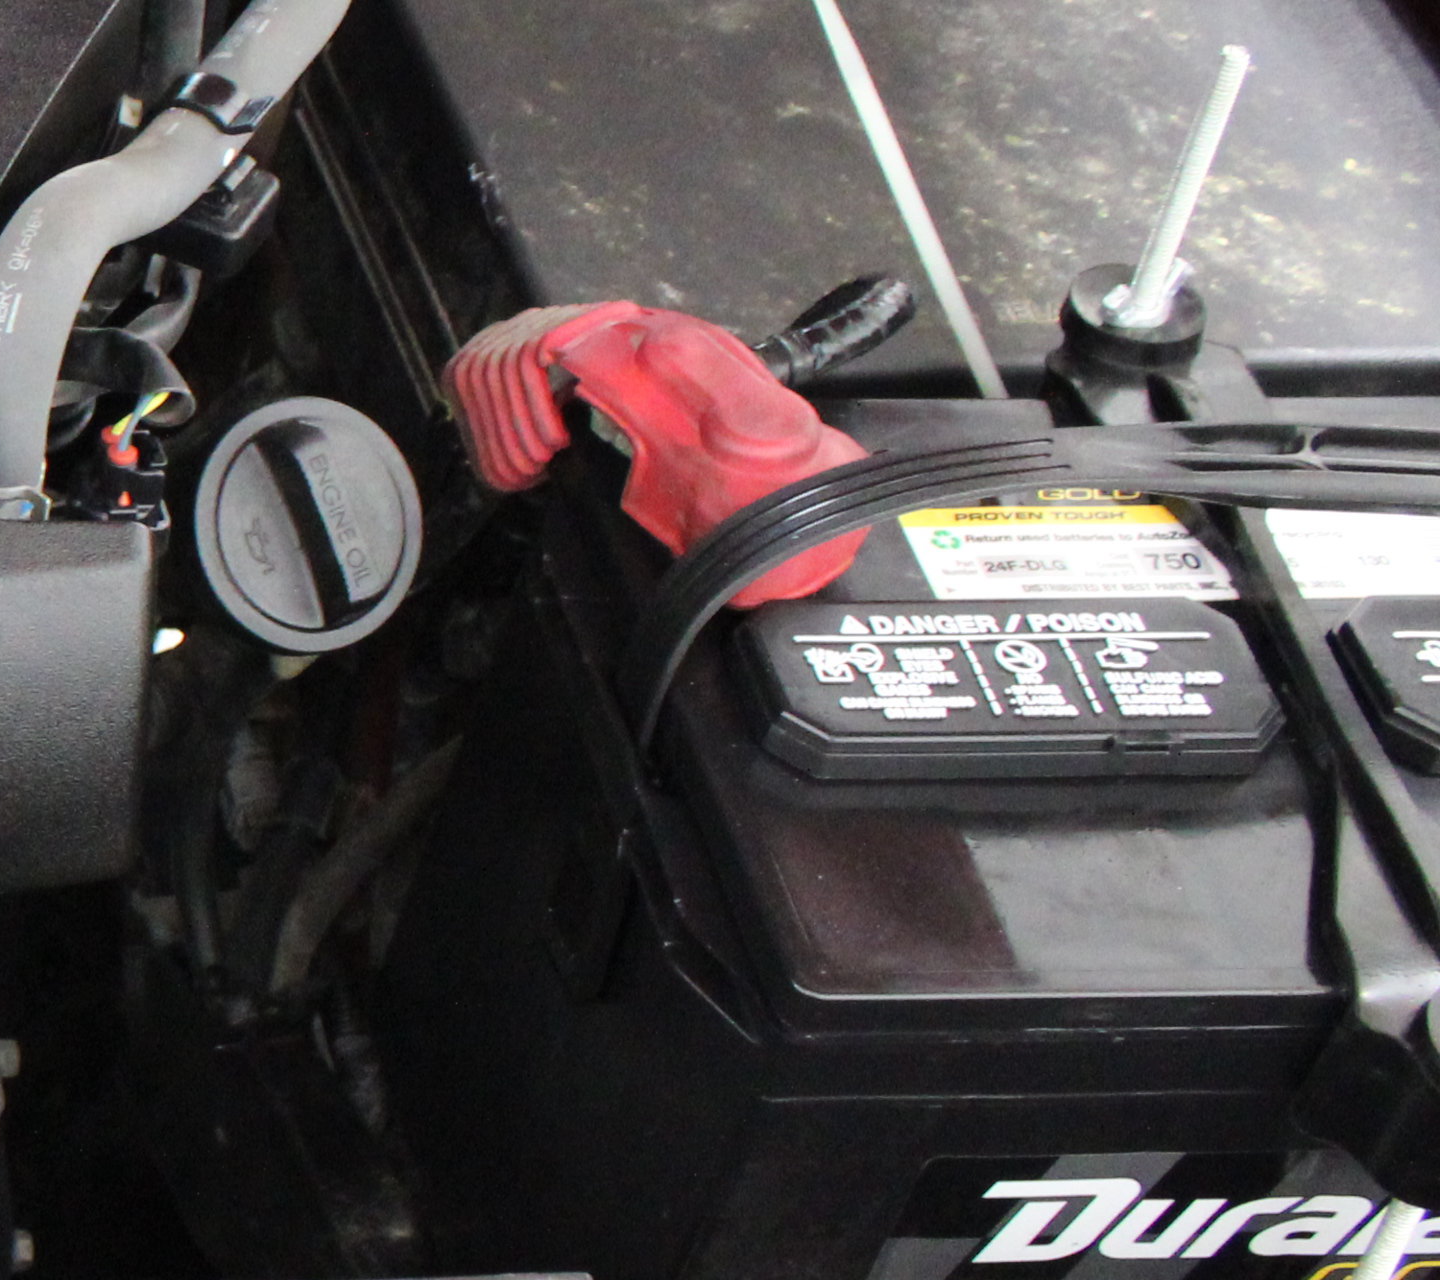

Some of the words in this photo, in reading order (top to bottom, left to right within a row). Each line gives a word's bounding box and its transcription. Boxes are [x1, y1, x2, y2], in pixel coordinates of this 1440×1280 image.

[1036, 487, 1142, 502] GOLD
[309, 453, 357, 546] ENGINE
[344, 547, 372, 589] OIL
[954, 510, 1044, 522] PROVEN
[1052, 509, 1128, 521] TOUGH
[964, 533, 1013, 544] Return
[1016, 532, 1050, 543] used
[1053, 531, 1115, 543] batteries
[1119, 531, 1133, 542] to
[983, 558, 1069, 573] 24F-DLG
[1143, 552, 1202, 570] 750
[1021, 583, 1100, 594] DISTRIBUTED
[869, 614, 1001, 635] DANGER
[1026, 612, 1147, 633] POISON
[972, 1178, 1440, 1263] Dura
